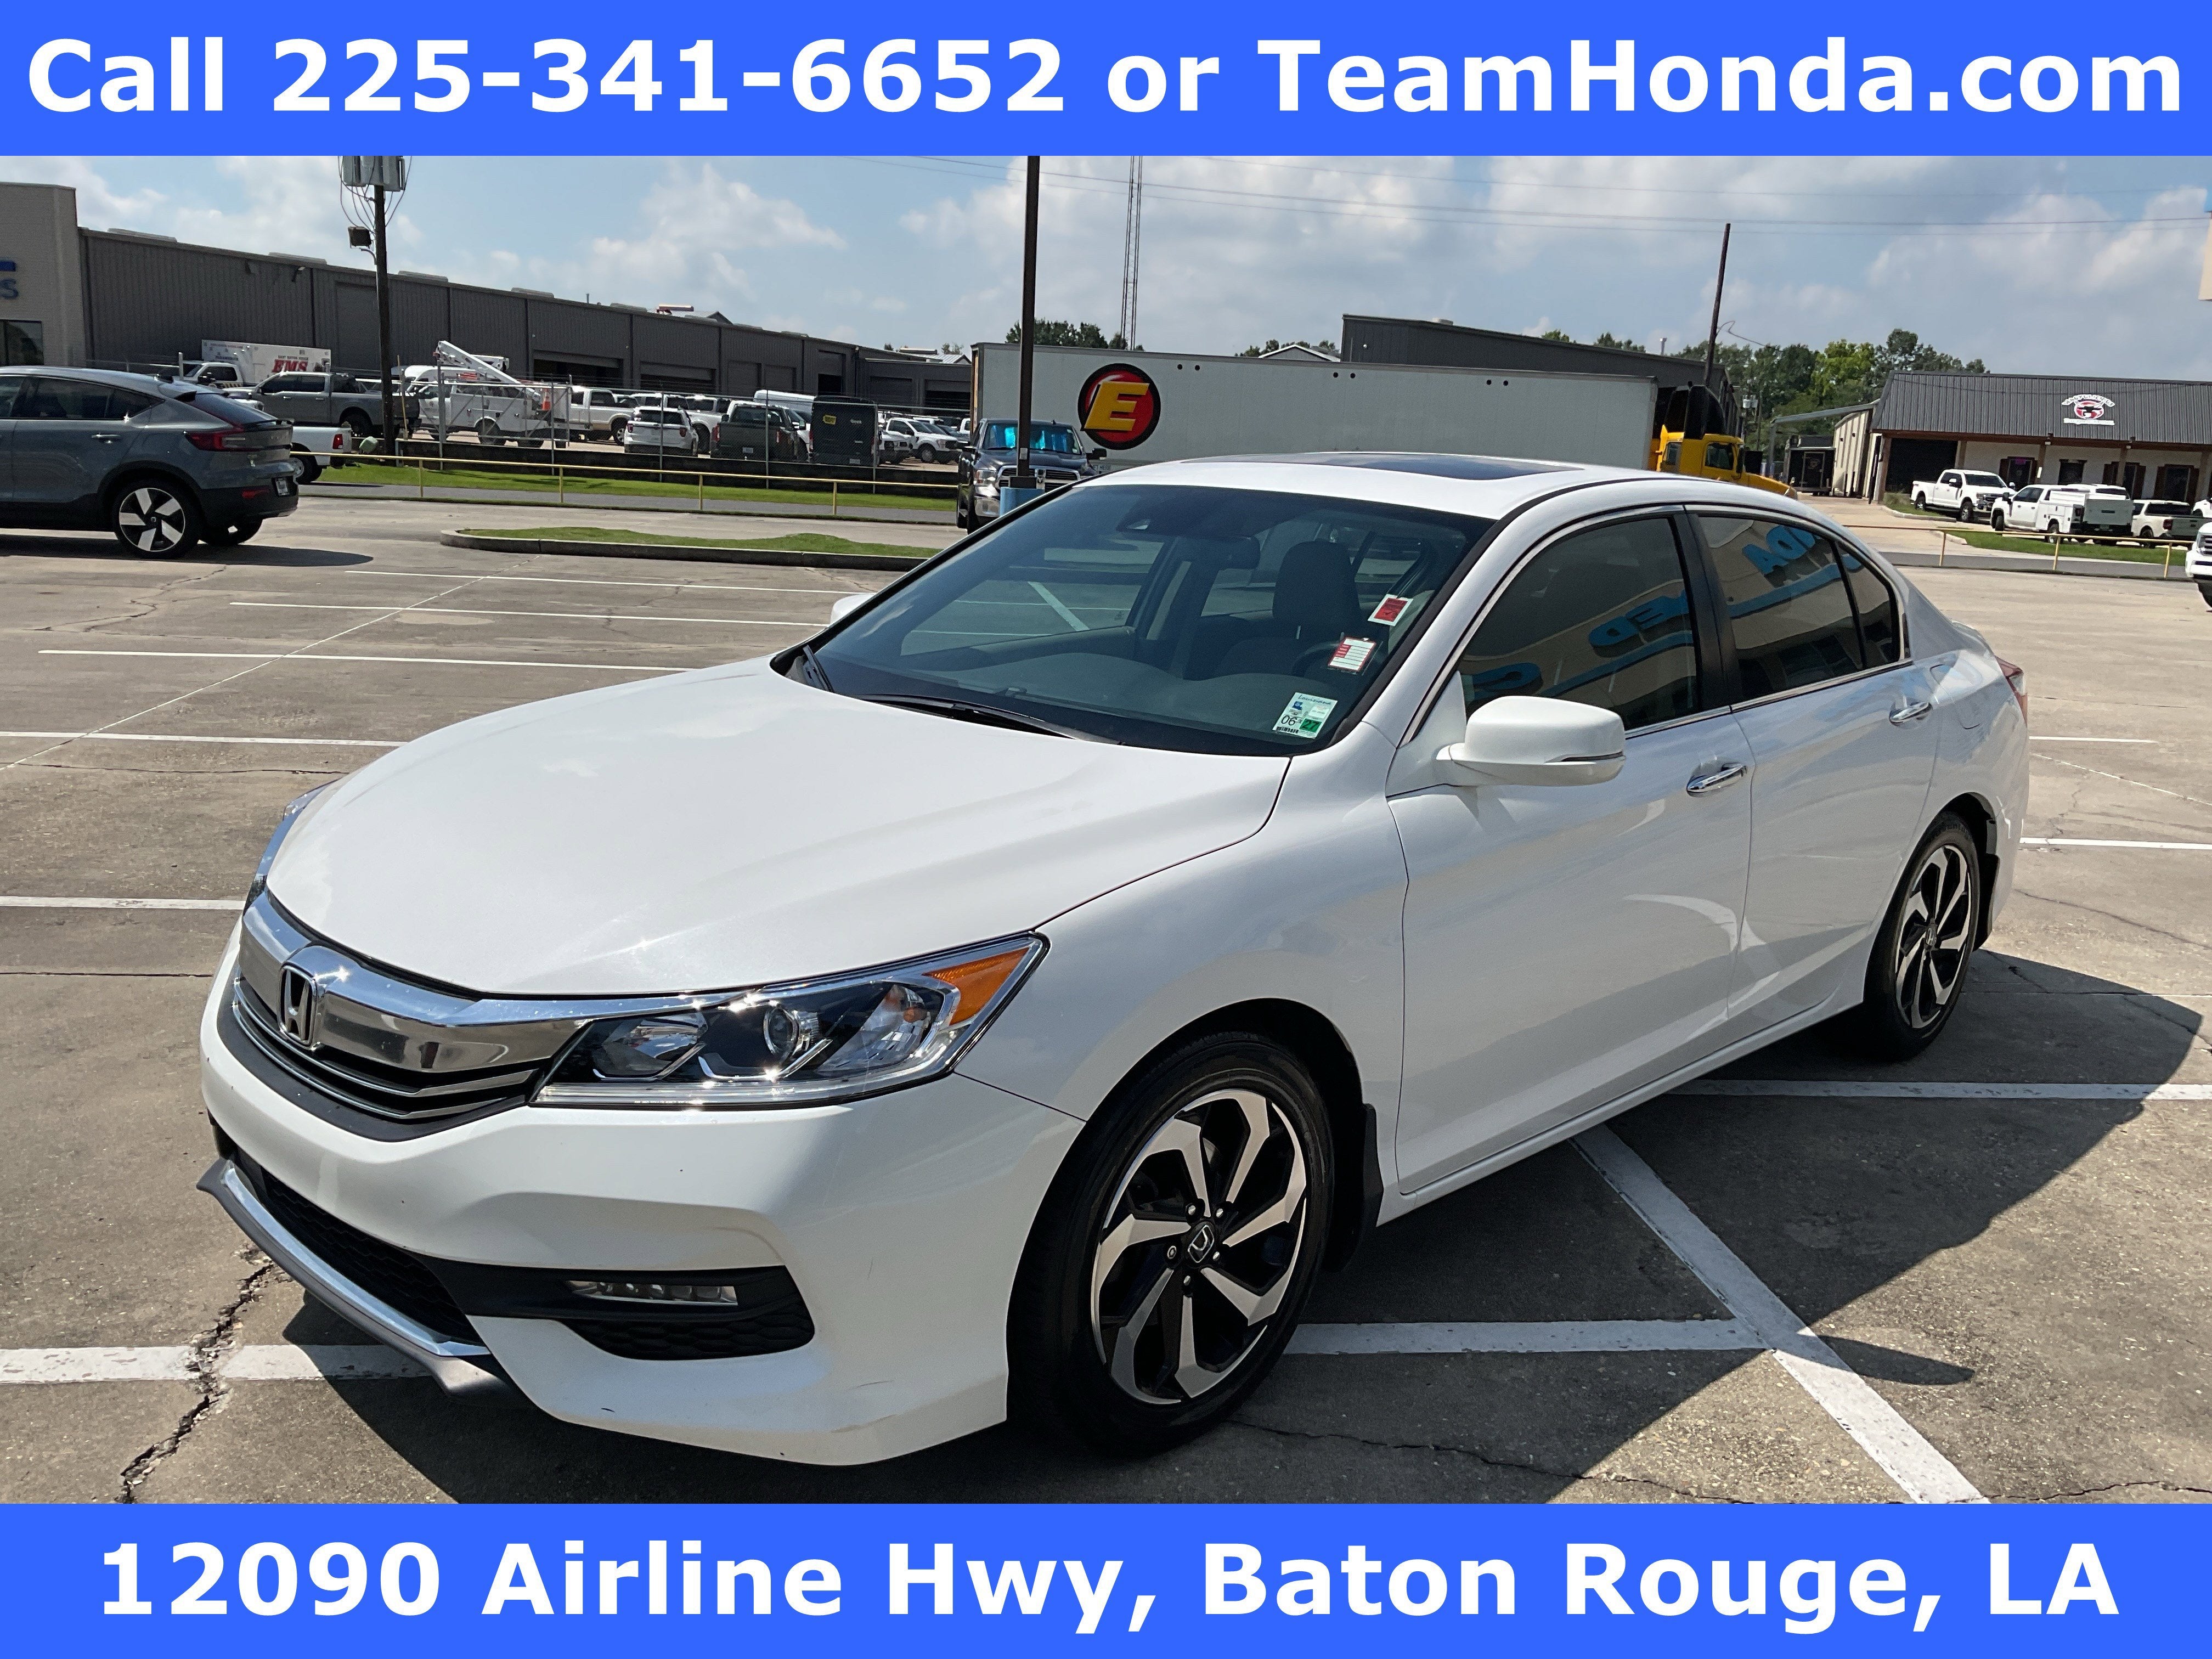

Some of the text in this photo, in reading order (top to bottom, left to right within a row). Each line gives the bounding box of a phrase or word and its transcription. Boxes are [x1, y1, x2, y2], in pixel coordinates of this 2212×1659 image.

[272, 359, 308, 373] EMS
[1281, 715, 1297, 726] 06
[1301, 719, 1321, 731] 27
